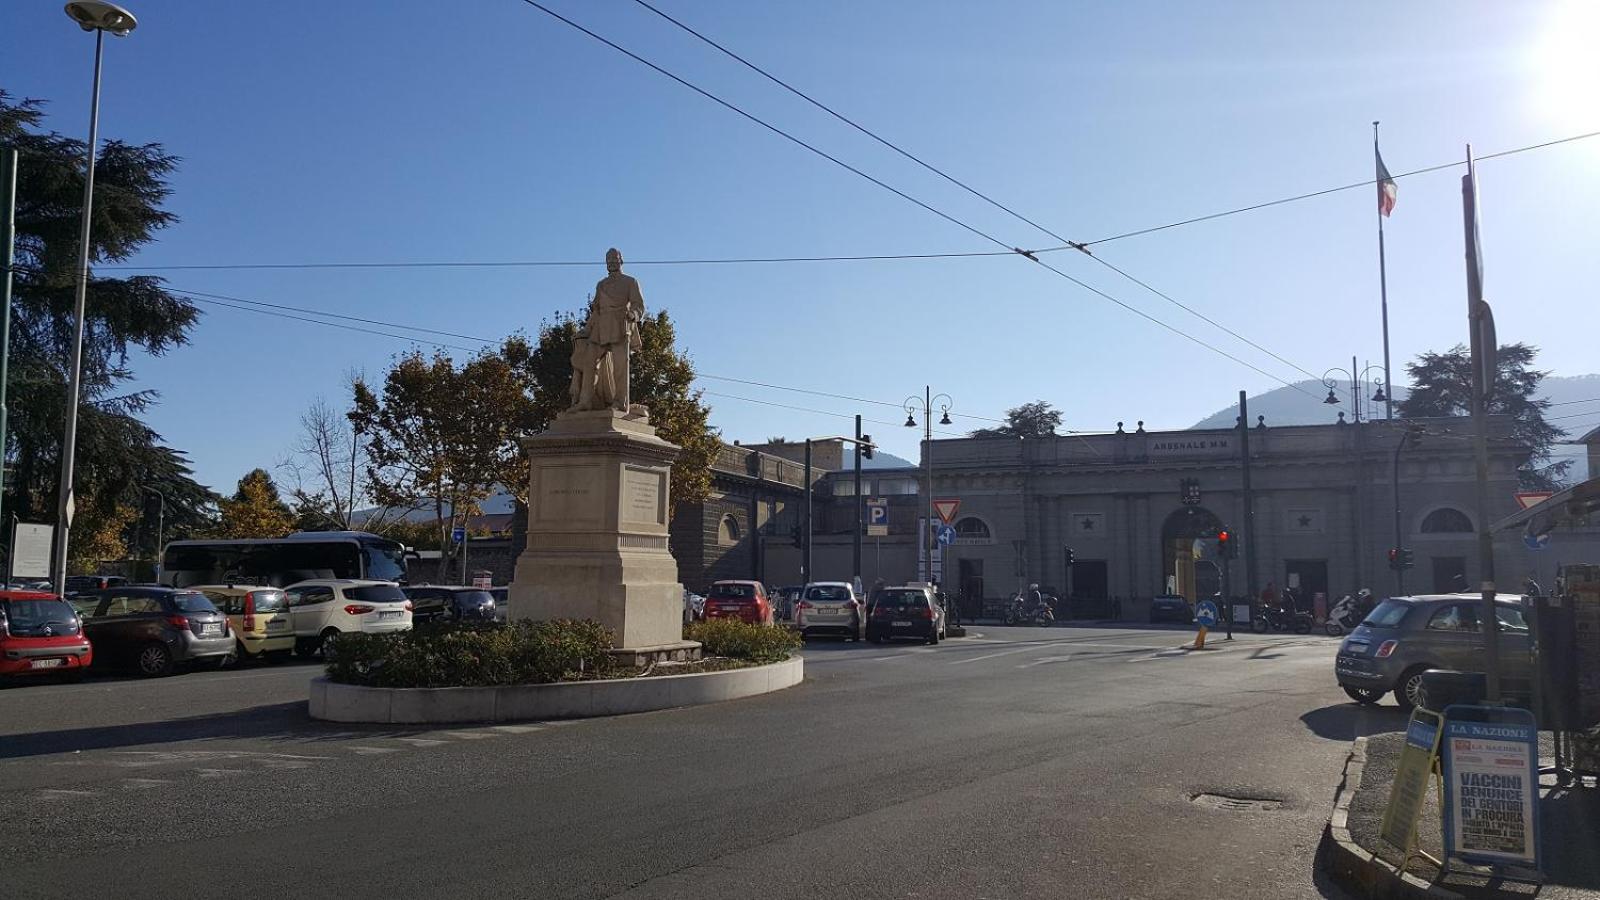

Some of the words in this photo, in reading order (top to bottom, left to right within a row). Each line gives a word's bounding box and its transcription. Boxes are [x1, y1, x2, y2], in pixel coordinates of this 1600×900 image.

[1153, 441, 1206, 450] ARSENALE
[871, 507, 884, 523] P
[1451, 724, 1467, 734] LA
[1472, 726, 1528, 738] NAZIONE
[1460, 772, 1522, 790] VACCINI
[1460, 786, 1523, 801] DENUNCE
[1461, 797, 1476, 808] DEI
[1480, 799, 1523, 812] GENITORI
[1461, 808, 1472, 819] IN
[1475, 809, 1524, 823] PROCURA
